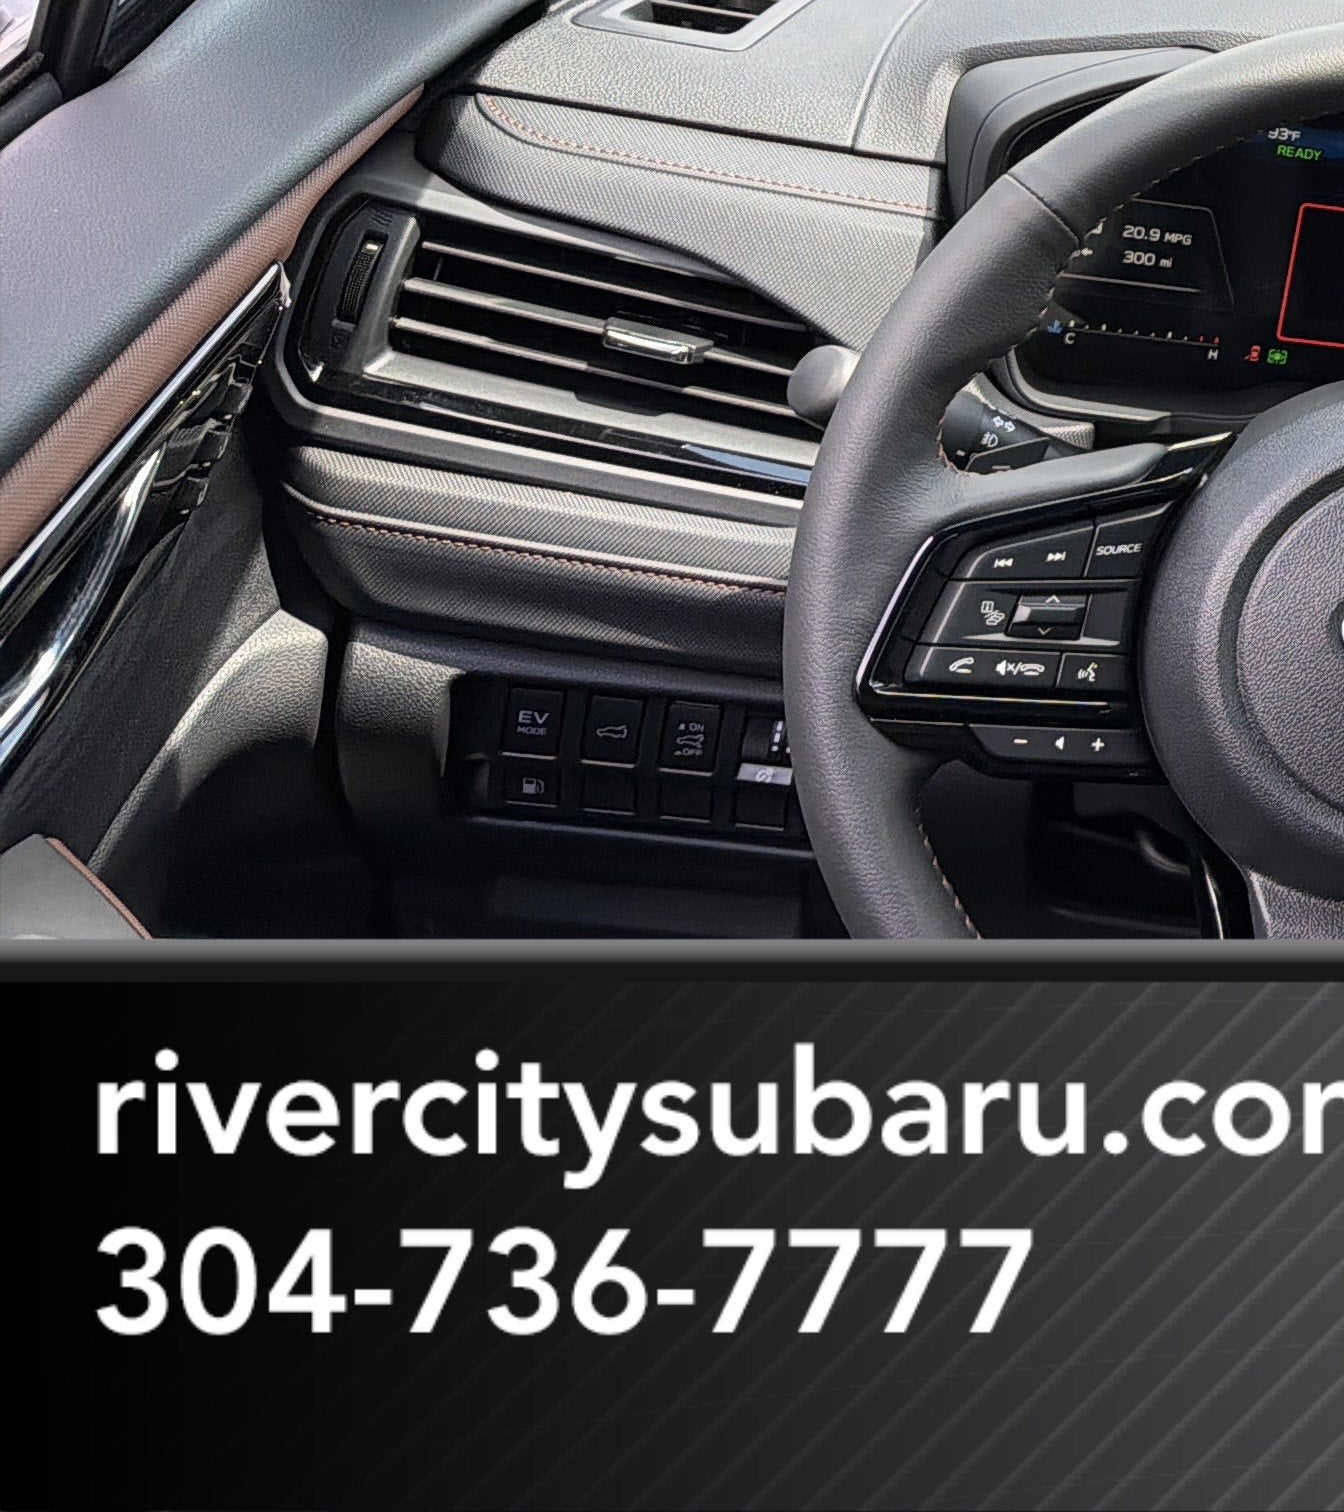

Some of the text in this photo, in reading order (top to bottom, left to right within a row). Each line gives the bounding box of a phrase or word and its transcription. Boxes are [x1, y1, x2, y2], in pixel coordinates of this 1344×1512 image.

[1277, 145, 1322, 160] READY
[1122, 224, 1192, 246] 20.9 MPG
[1122, 250, 1173, 268] 300 mi
[1063, 332, 1076, 345] C
[1207, 349, 1219, 360] H
[1096, 543, 1143, 556] SOURCE
[518, 709, 550, 725] EV
[516, 725, 548, 736] MODE
[689, 723, 705, 732] ON
